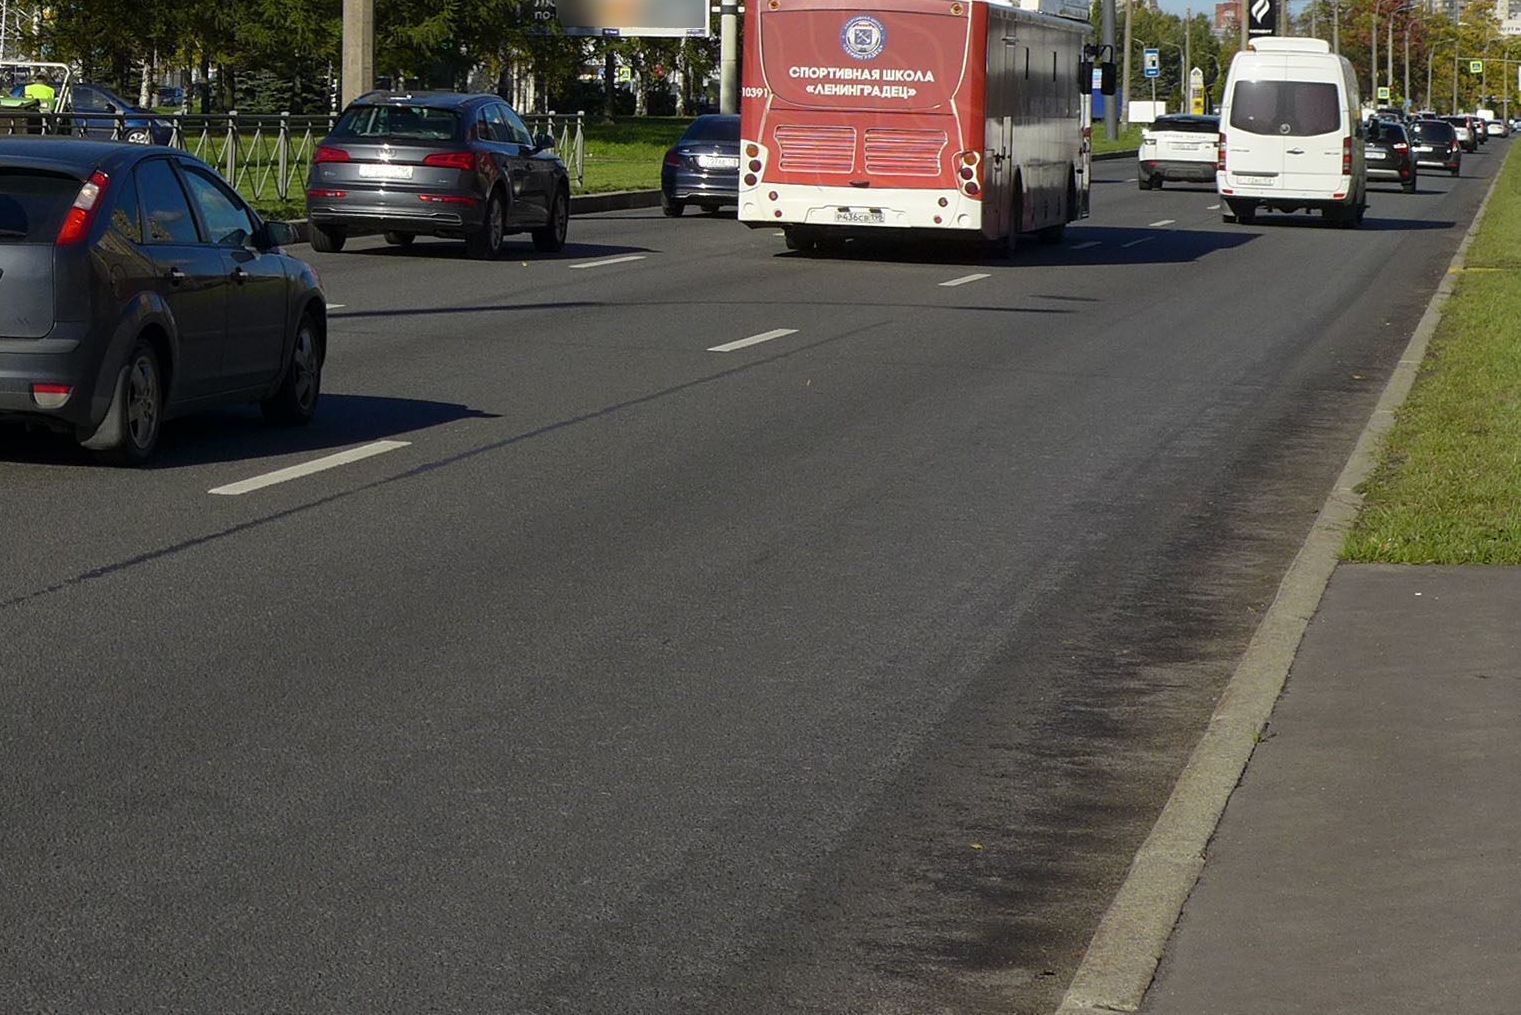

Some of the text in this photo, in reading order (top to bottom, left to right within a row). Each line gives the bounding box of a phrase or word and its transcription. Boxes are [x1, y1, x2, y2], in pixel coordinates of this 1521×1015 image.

[788, 66, 935, 83] СПОРТИВНАЯ ШКОЛА
[741, 87, 768, 98] 10391
[805, 84, 917, 99] «ЛЕНИНГРАДЕЦ»
